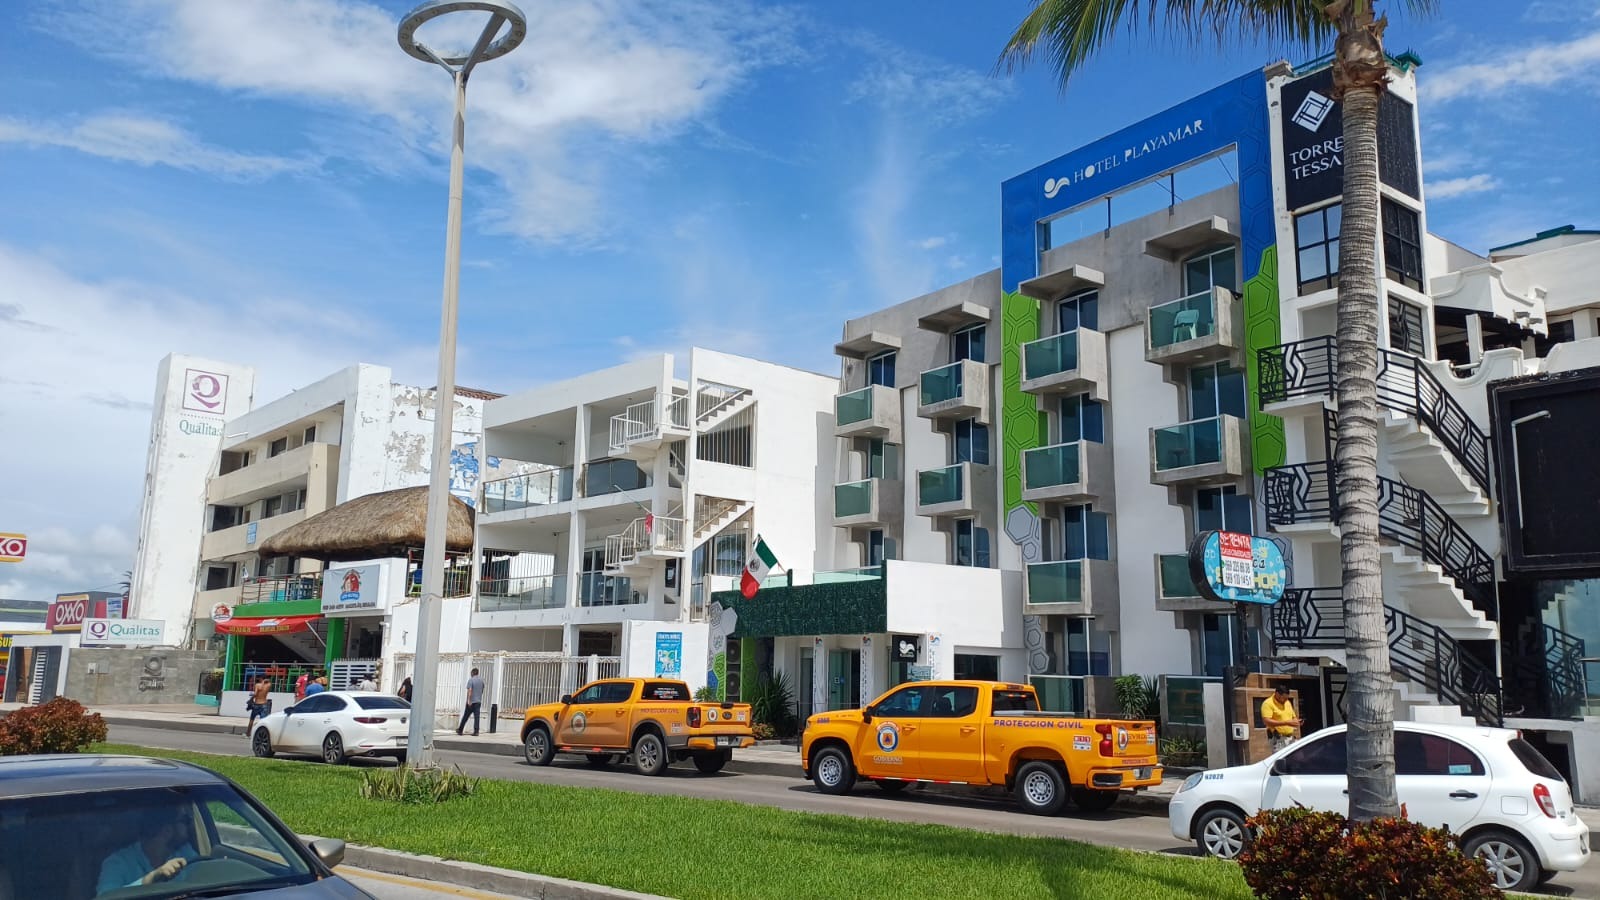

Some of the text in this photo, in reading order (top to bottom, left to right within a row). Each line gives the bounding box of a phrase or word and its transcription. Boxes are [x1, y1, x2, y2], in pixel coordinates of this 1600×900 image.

[1074, 119, 1204, 183] HOTEL PLAYAMAR
[1289, 136, 1344, 165] TORRE
[1292, 155, 1342, 180] TESSA
[1219, 532, 1251, 549] SE RENTA
[55, 600, 85, 626] OXXO
[993, 719, 1084, 729] PROTECCION CIVIL
